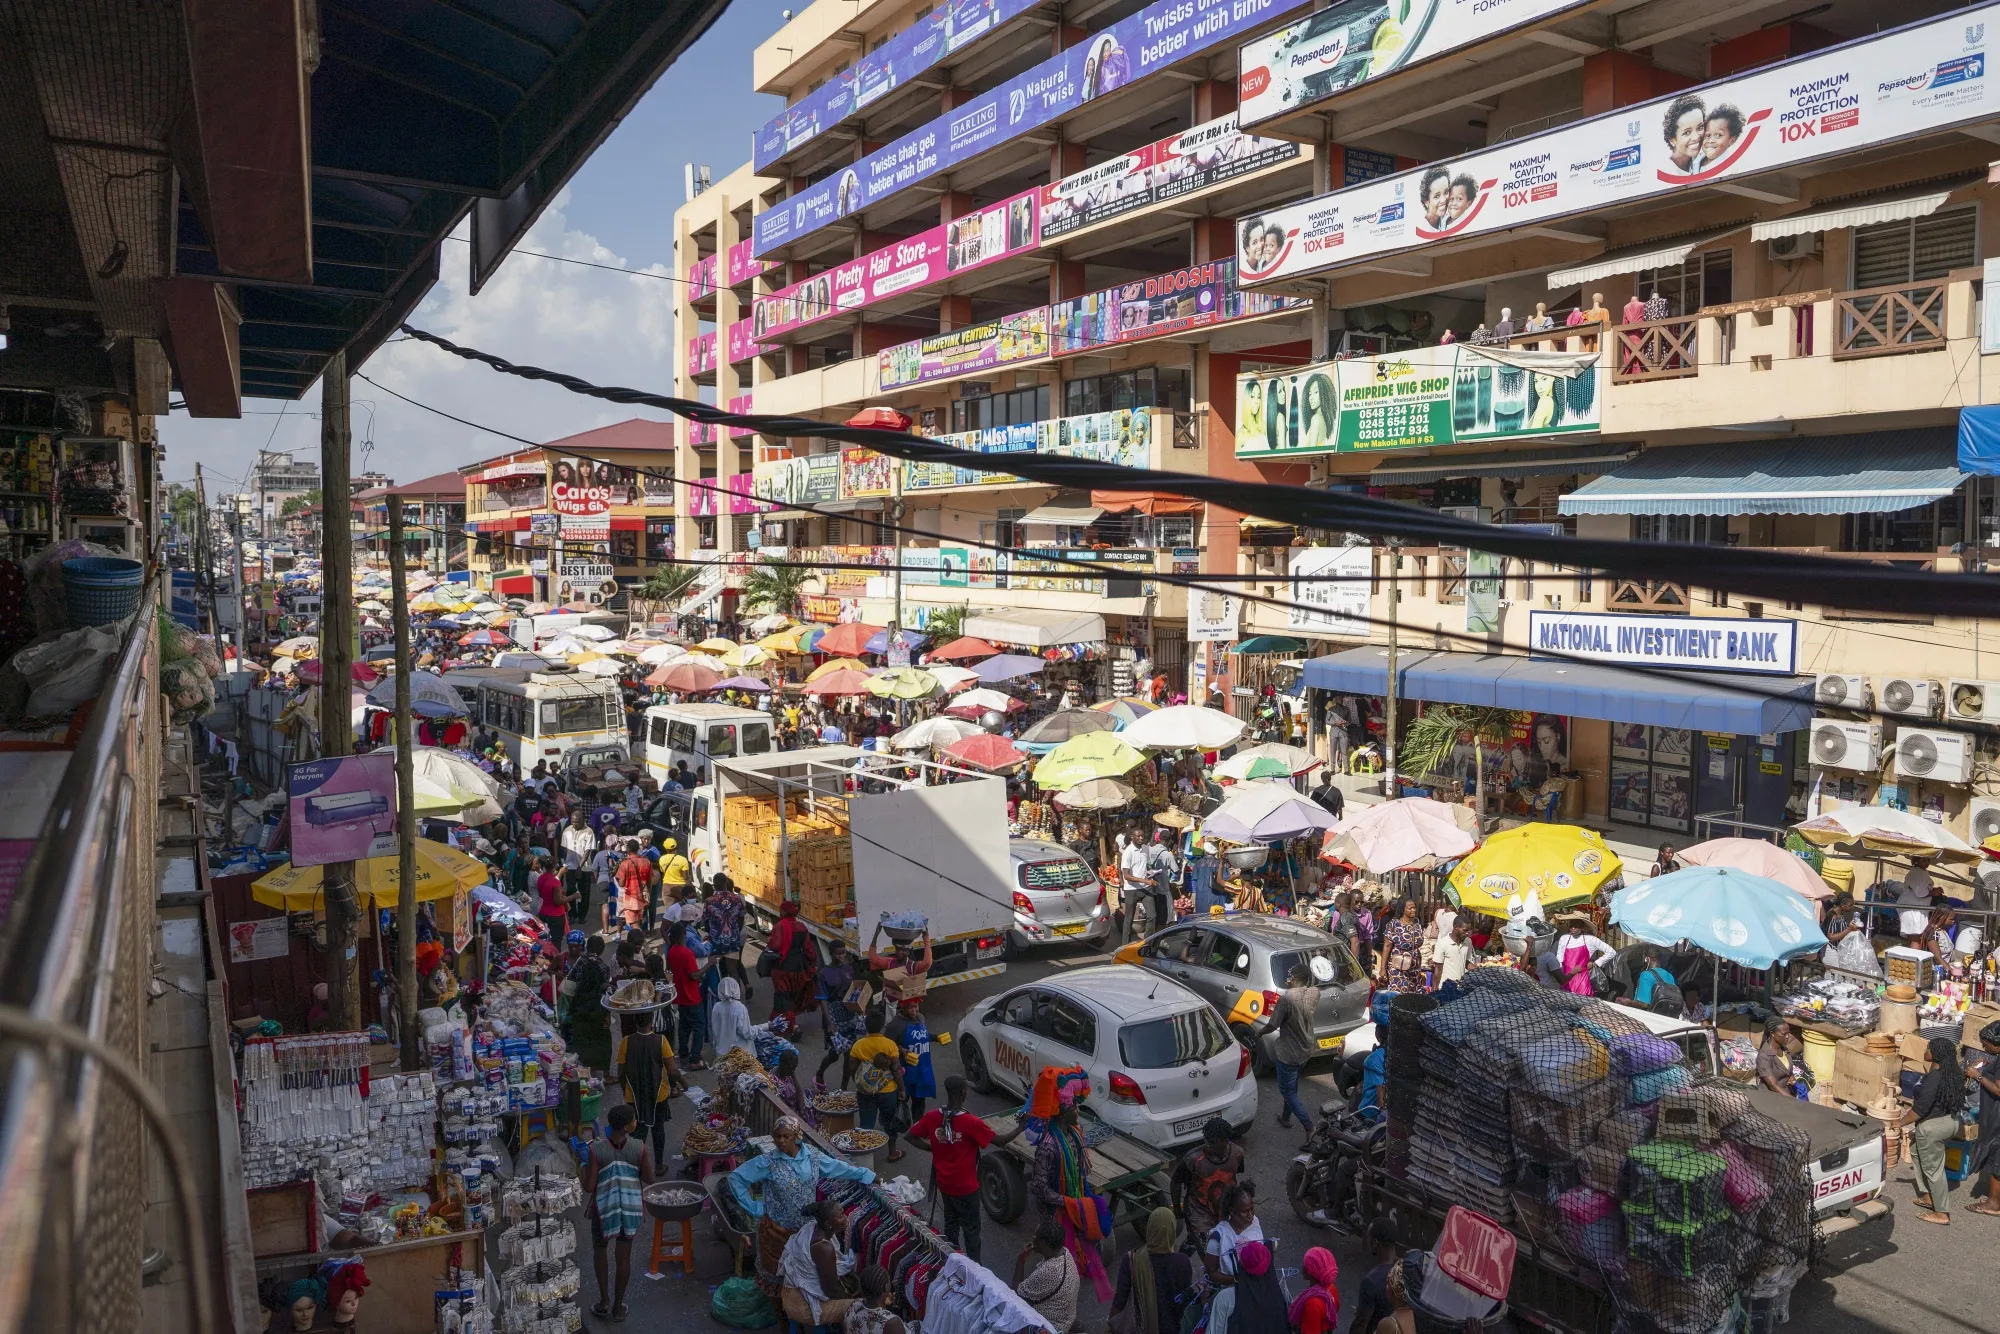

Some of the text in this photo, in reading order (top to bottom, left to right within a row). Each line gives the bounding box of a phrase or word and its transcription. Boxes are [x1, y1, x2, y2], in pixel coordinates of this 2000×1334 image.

[1141, 0, 1272, 66] better with time
[1290, 39, 1341, 67] Pepsodent
[1026, 65, 1068, 98] Natural
[1241, 74, 1265, 93] NEW
[1789, 72, 1849, 97] MAXIMUM
[1878, 72, 1928, 93] Pepsodent
[1042, 82, 1074, 108] Twist
[1797, 87, 1841, 107] CAVITY
[1912, 96, 1933, 106] Every
[1934, 90, 1954, 101] Smile
[1956, 83, 1985, 95] Matters
[1780, 94, 1859, 123] PROTECTION
[953, 108, 994, 136] DARLING
[1779, 110, 1855, 144] 10X STRONGER
[1830, 122, 1848, 130] TEETH
[950, 125, 997, 152] #FindYourBeautiful
[1179, 132, 1204, 149] WINI'S
[1206, 125, 1221, 139] BRA
[1224, 122, 1229, 131] &
[870, 132, 936, 177] Twists that get
[1509, 152, 1551, 171] MAXIMUM
[1514, 163, 1545, 179] CAVITY
[1570, 158, 1604, 172] Pepsodent
[868, 154, 937, 197] better with time
[1059, 178, 1079, 194] WINI'S
[1081, 173, 1092, 186] BRA
[1093, 171, 1098, 180] &
[1100, 159, 1130, 178] LINGERIE
[1194, 179, 1205, 188] 777
[1502, 171, 1557, 192] PROTECTION
[1593, 177, 1606, 185] Every
[1607, 173, 1621, 181] Smile
[1622, 169, 1641, 178] Matters
[806, 189, 830, 210] Natural
[1502, 189, 1527, 209] 10X
[814, 202, 834, 220] Twist
[1308, 206, 1339, 222] MAXIMUM
[762, 211, 788, 232] DARLING
[1303, 222, 1344, 240] PROTECTION
[1312, 215, 1335, 230] CAVITY
[1303, 239, 1323, 254] 10X
[836, 264, 864, 291] Pretty
[869, 251, 891, 277] Hair
[896, 241, 925, 268] Store
[1146, 264, 1214, 299] DIDOSH
[961, 326, 997, 344] VENTURES
[1343, 377, 1449, 402] AFRIPRIDE WIG SHOP
[1393, 396, 1416, 404] Wholesale
[1359, 403, 1430, 419] 0548 234 778
[1359, 414, 1429, 430] 0245 654 201
[982, 428, 1007, 447] Miss
[1359, 425, 1429, 439] 0208 117 934
[1354, 441, 1369, 449] New
[1371, 439, 1397, 447] Makola
[1399, 437, 1416, 445] Mall
[1424, 435, 1435, 443] 63
[553, 482, 610, 501] Caro's
[556, 501, 607, 513] Wigs Gh.
[848, 546, 871, 554] COSMETICS
[560, 565, 613, 576] BEST HAIR
[916, 557, 922, 565] OF
[922, 557, 939, 566] BEAUTY
[1540, 622, 1779, 663] NATIONAL INVESTMENT BANK
[293, 772, 324, 781] Everyone
[1577, 852, 1598, 873] DORA
[1484, 879, 1515, 891] DORA
[995, 1037, 1031, 1078] YANGO
[1176, 1124, 1186, 1132] GX
[1813, 1168, 1863, 1199] ISSAN
